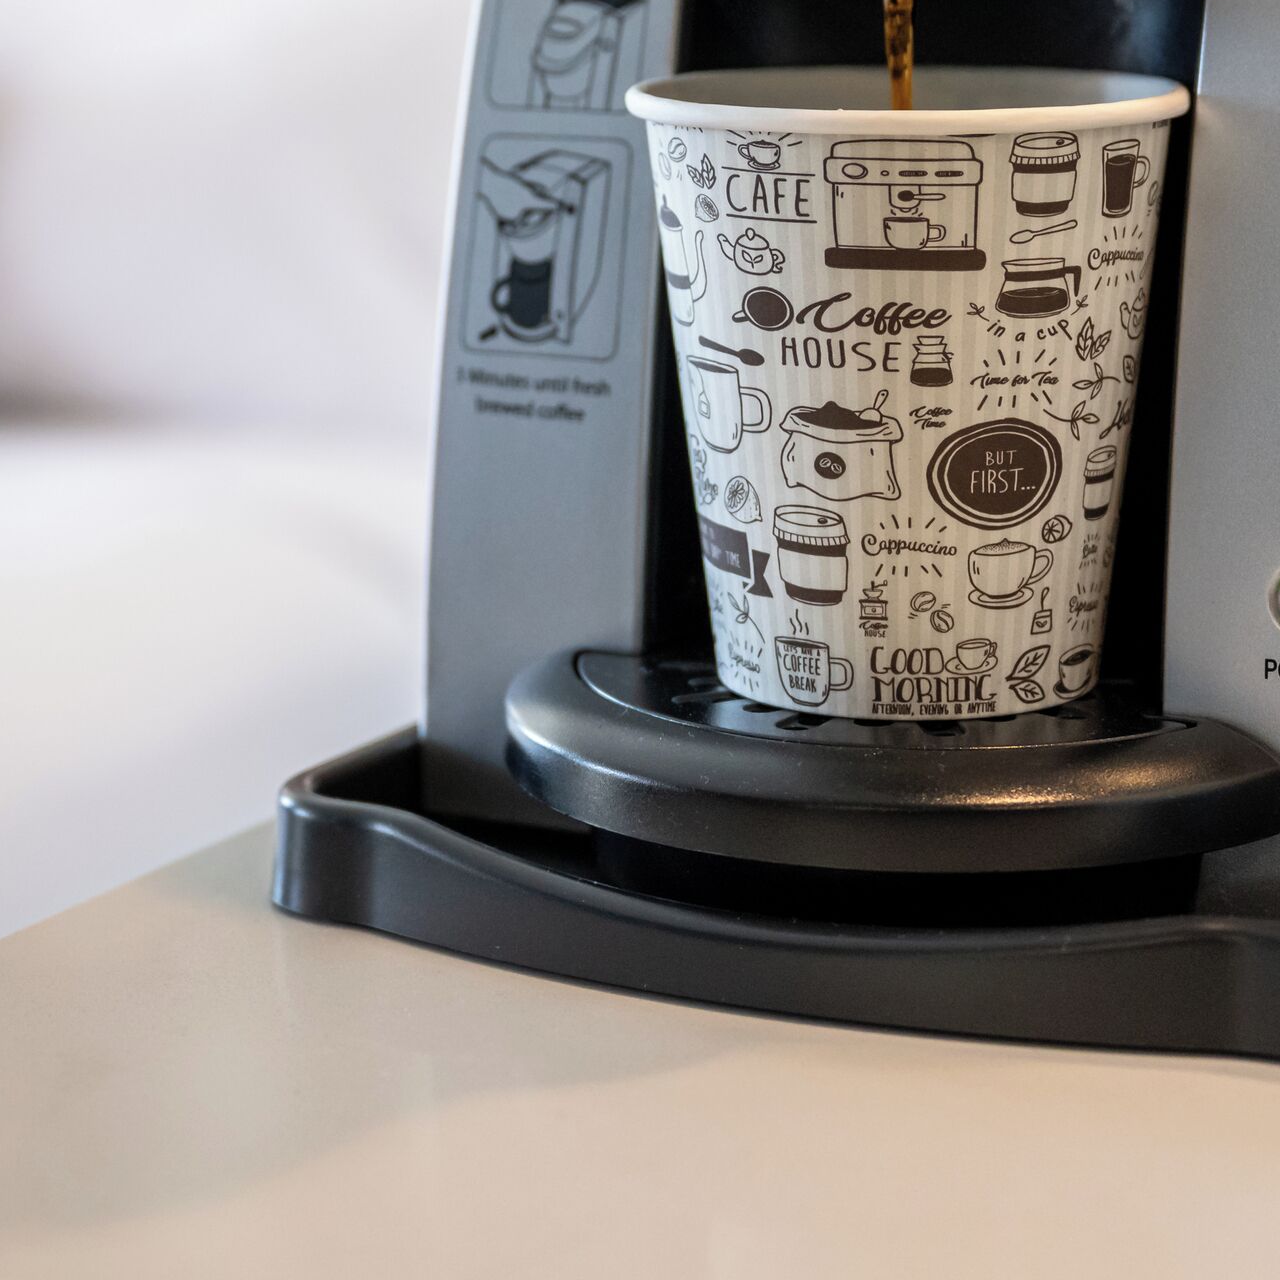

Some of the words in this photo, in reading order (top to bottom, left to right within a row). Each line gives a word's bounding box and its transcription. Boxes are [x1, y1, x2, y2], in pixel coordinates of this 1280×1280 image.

[726, 174, 810, 217] CAFE
[795, 292, 953, 335] Coffee
[987, 320, 1006, 337] in
[1015, 332, 1025, 342] a
[1037, 319, 1072, 341] cup
[781, 336, 902, 372] HOUSE
[970, 373, 1008, 389] Time
[1011, 375, 1030, 387] for
[1031, 371, 1059, 386] Tea
[909, 405, 953, 419] Coffee
[913, 417, 946, 430] Time
[985, 450, 1017, 466] BUT
[970, 467, 1036, 494] FIRST...
[861, 533, 957, 557] Cappuccino
[783, 653, 821, 676] COFFEE
[870, 646, 945, 675] GOOD
[788, 674, 817, 693] BREAK
[870, 673, 997, 703] MORNING
